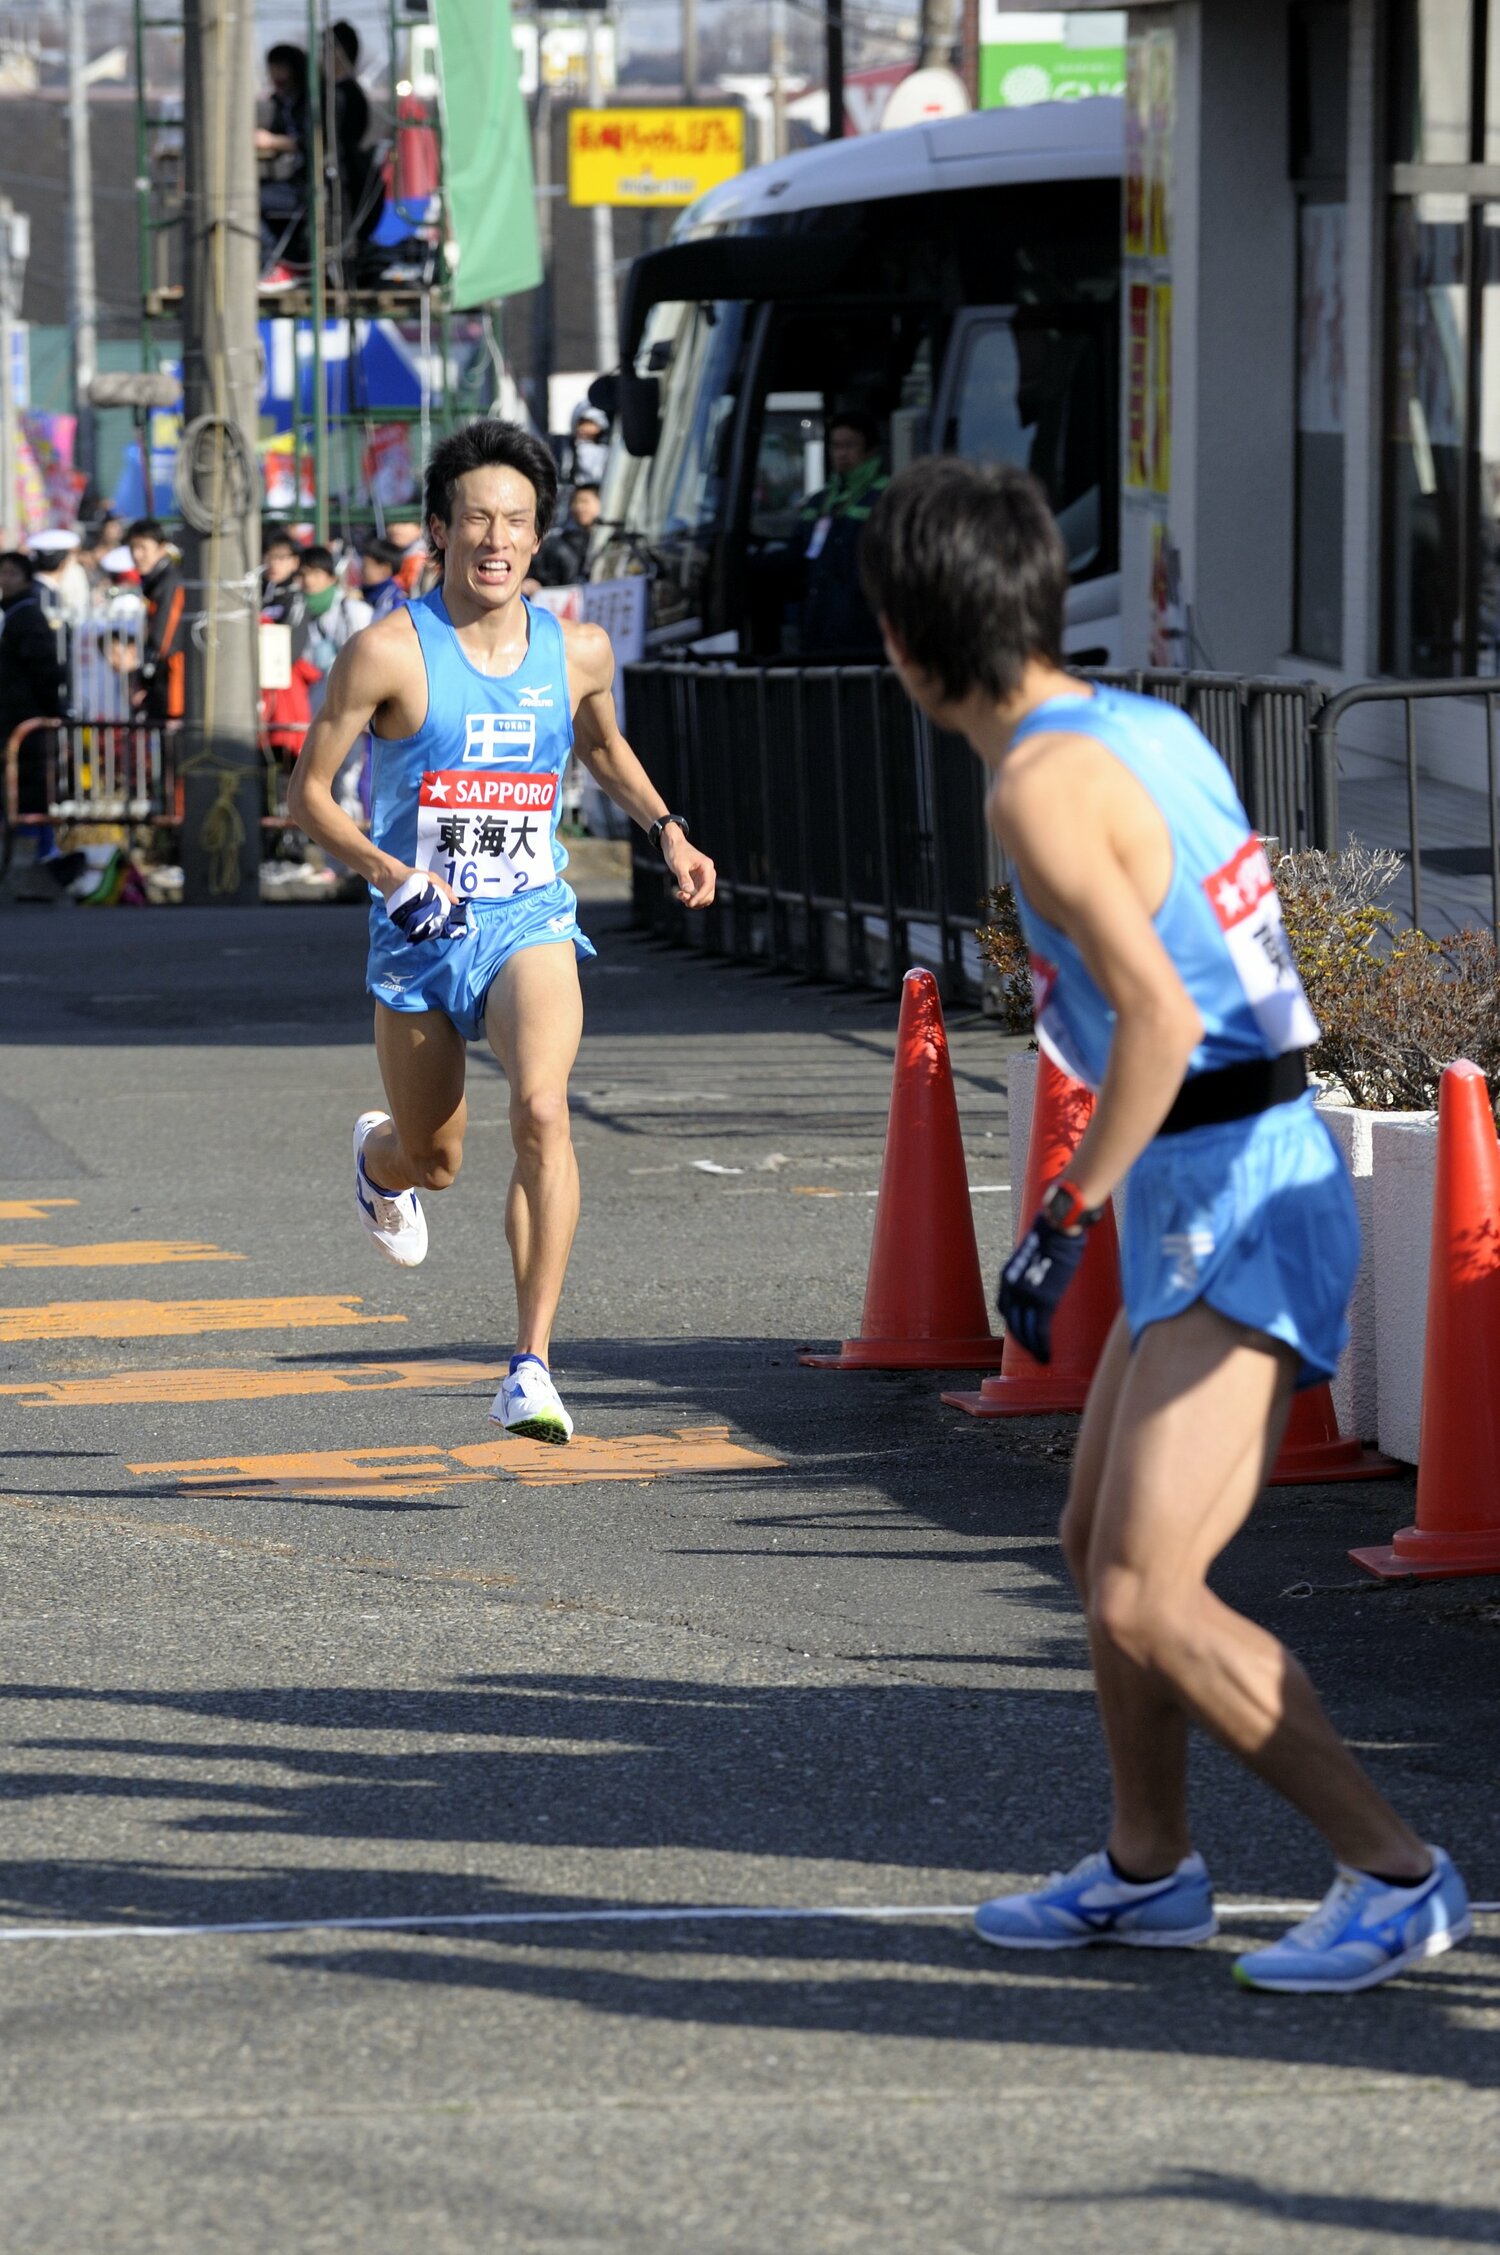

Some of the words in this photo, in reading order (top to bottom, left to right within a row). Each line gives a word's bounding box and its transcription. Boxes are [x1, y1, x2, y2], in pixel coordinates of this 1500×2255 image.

[498, 720, 527, 731] TOKAI
[455, 779, 554, 805] SAPPORO
[436, 814, 538, 860] 東海大
